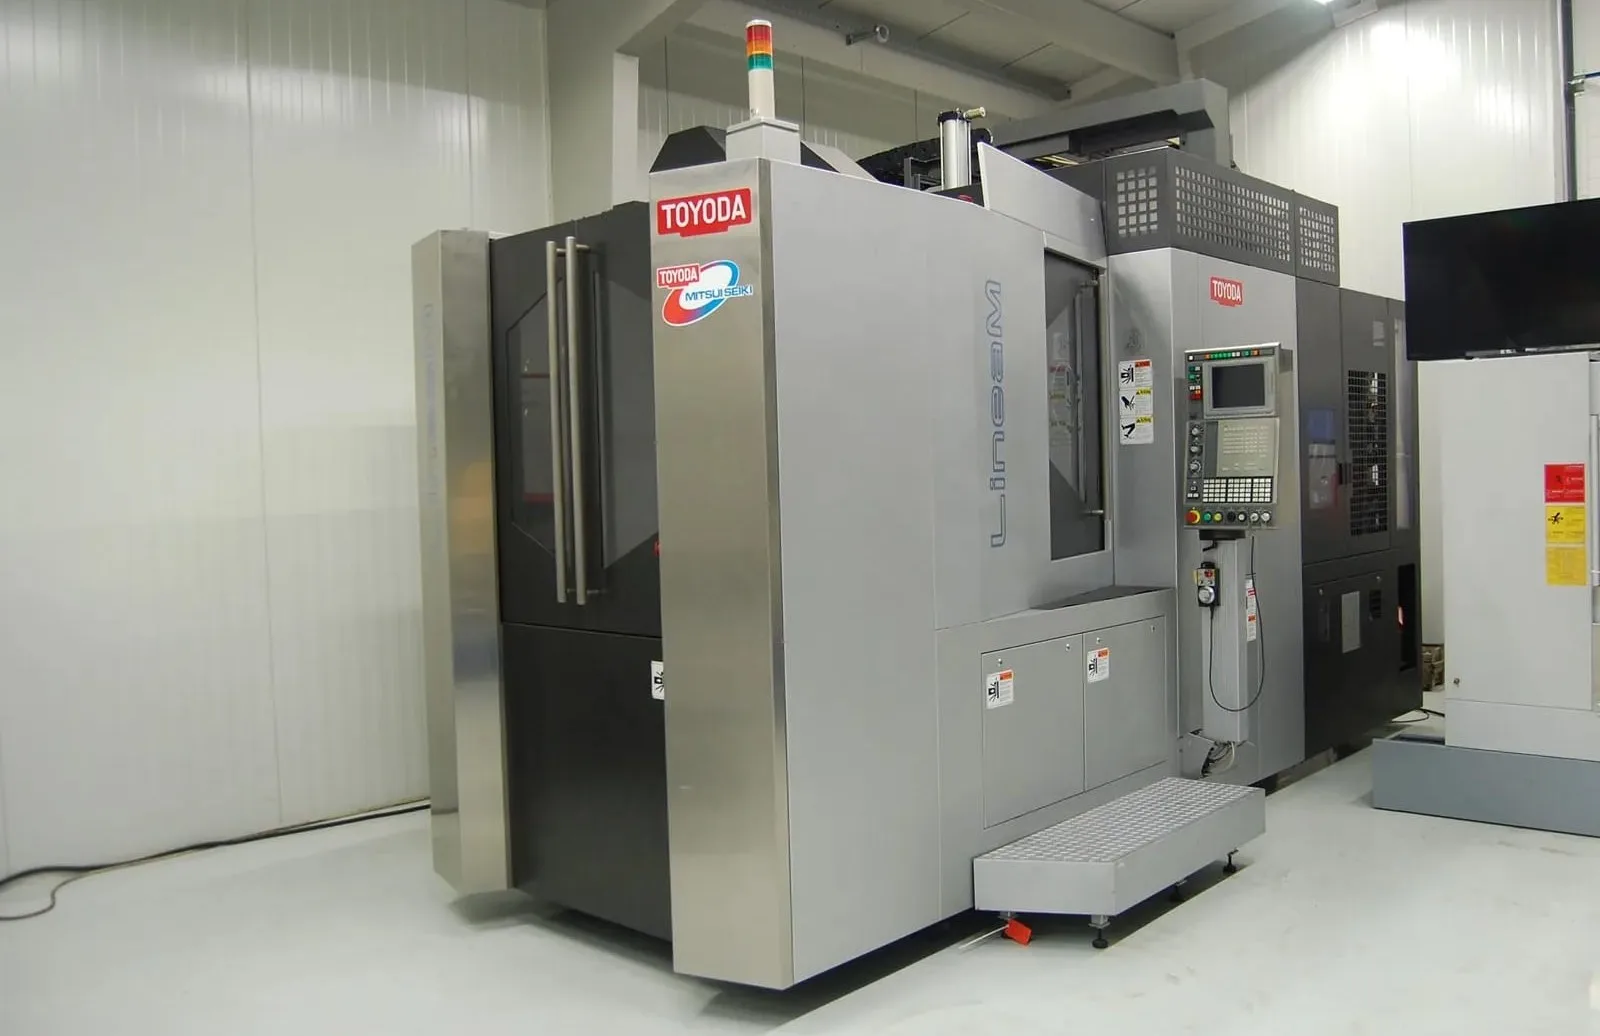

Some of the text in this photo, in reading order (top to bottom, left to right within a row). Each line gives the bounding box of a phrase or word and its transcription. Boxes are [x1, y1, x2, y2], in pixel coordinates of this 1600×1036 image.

[661, 194, 747, 229] TOYODA
[659, 268, 698, 285] TOYODA
[685, 285, 753, 302] MITSUI SEIKI
[1212, 280, 1241, 302] TOYODA
[985, 280, 1006, 549] LineaM
